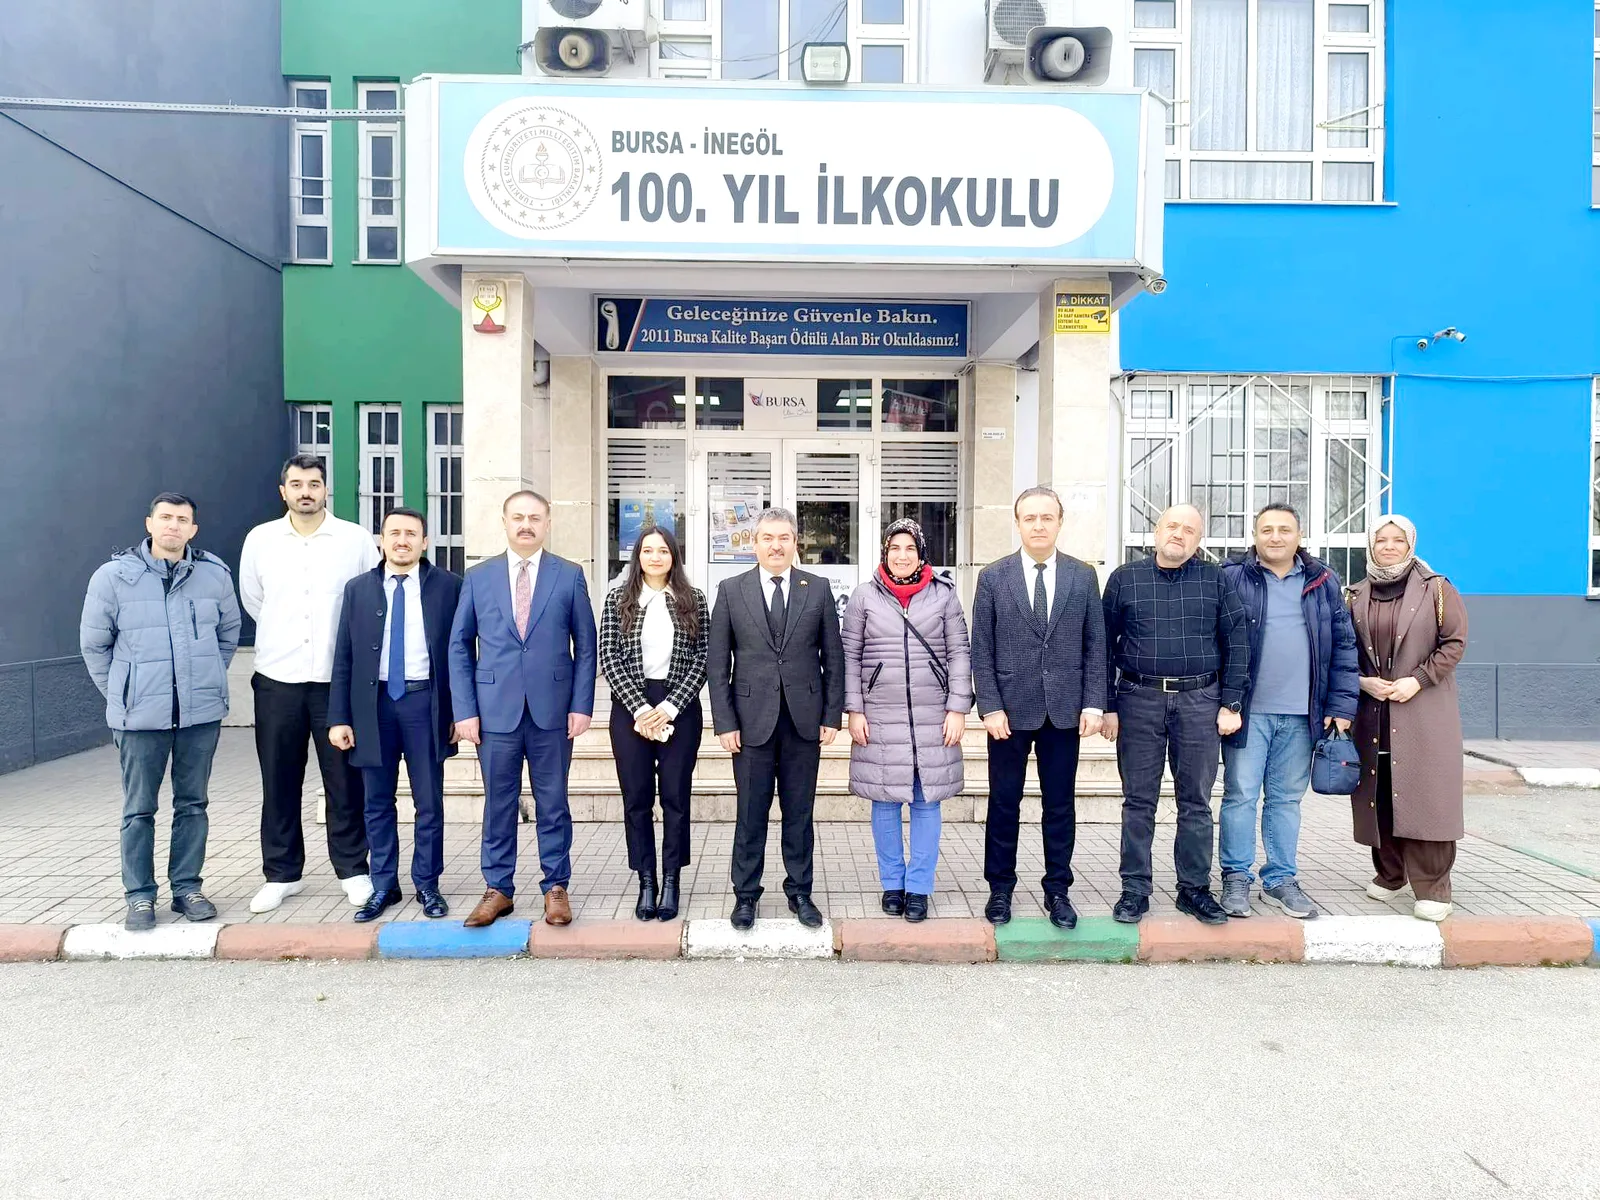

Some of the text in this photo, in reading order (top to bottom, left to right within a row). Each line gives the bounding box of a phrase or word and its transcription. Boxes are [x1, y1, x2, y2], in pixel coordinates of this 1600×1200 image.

[611, 130, 684, 154] BURSA
[704, 127, 783, 156] İNEGÖL
[611, 162, 1060, 229] 100. YIL İLKOKULU
[1071, 295, 1105, 304] DİKKAT
[666, 305, 938, 326] Geleceğinize Güvenle Bakın.
[641, 327, 959, 349] 2011 Bursa Kalite Başarı Ödülü Alan Bir Okuldasınız!
[766, 396, 806, 407] BURSA
